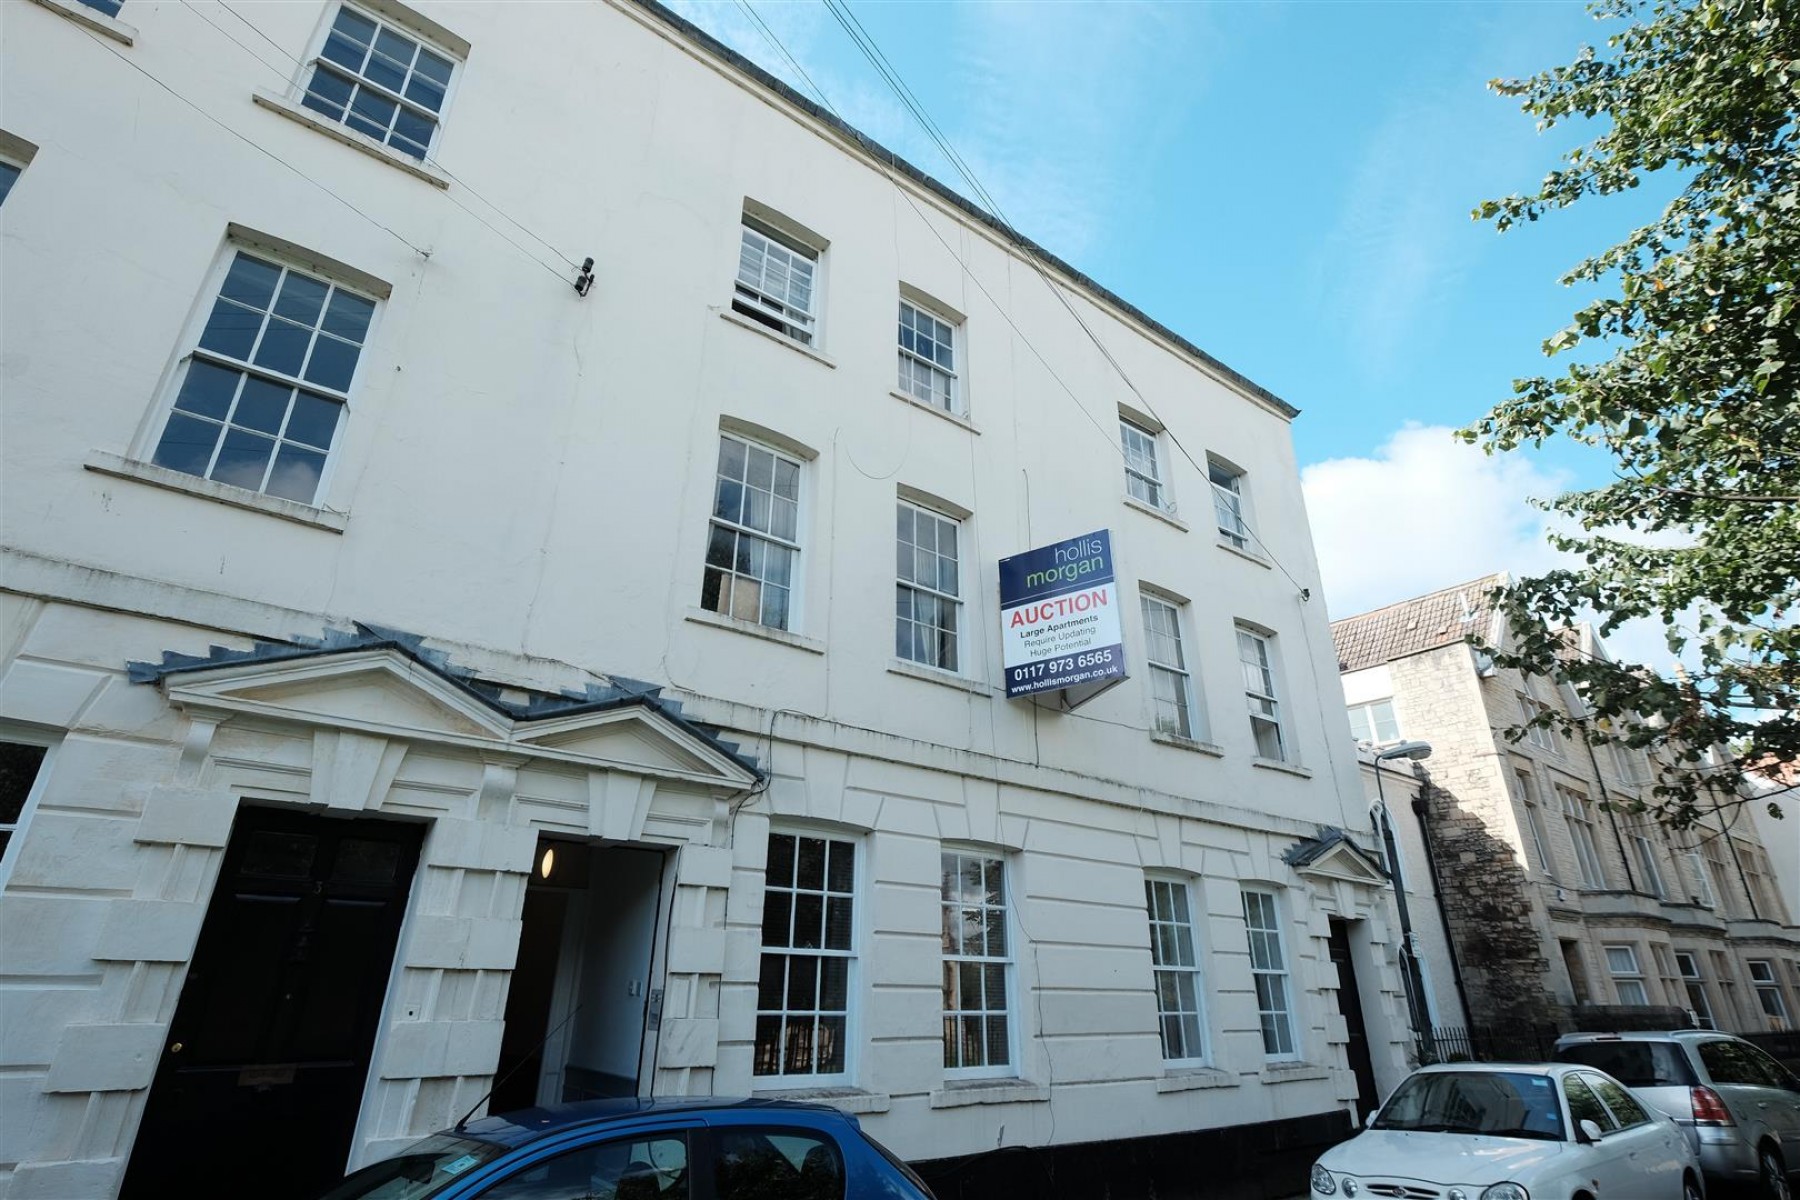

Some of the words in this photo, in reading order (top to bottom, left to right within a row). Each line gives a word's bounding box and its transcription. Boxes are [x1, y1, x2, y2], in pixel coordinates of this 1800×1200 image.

[1055, 539, 1102, 564] hollis
[1027, 556, 1104, 588] morgan
[1010, 589, 1108, 628] AUCTION
[1020, 628, 1045, 638] Large
[1047, 615, 1099, 632] Apartments
[1024, 636, 1056, 649] Require
[1058, 626, 1096, 641] Updating
[1030, 648, 1052, 657] Huge
[1054, 638, 1092, 652] Potential
[1014, 663, 1045, 681] 0117
[1049, 658, 1074, 673] 973
[1078, 649, 1112, 667] 6565
[1011, 665, 1118, 693] www.hollismorgan.co.uk
